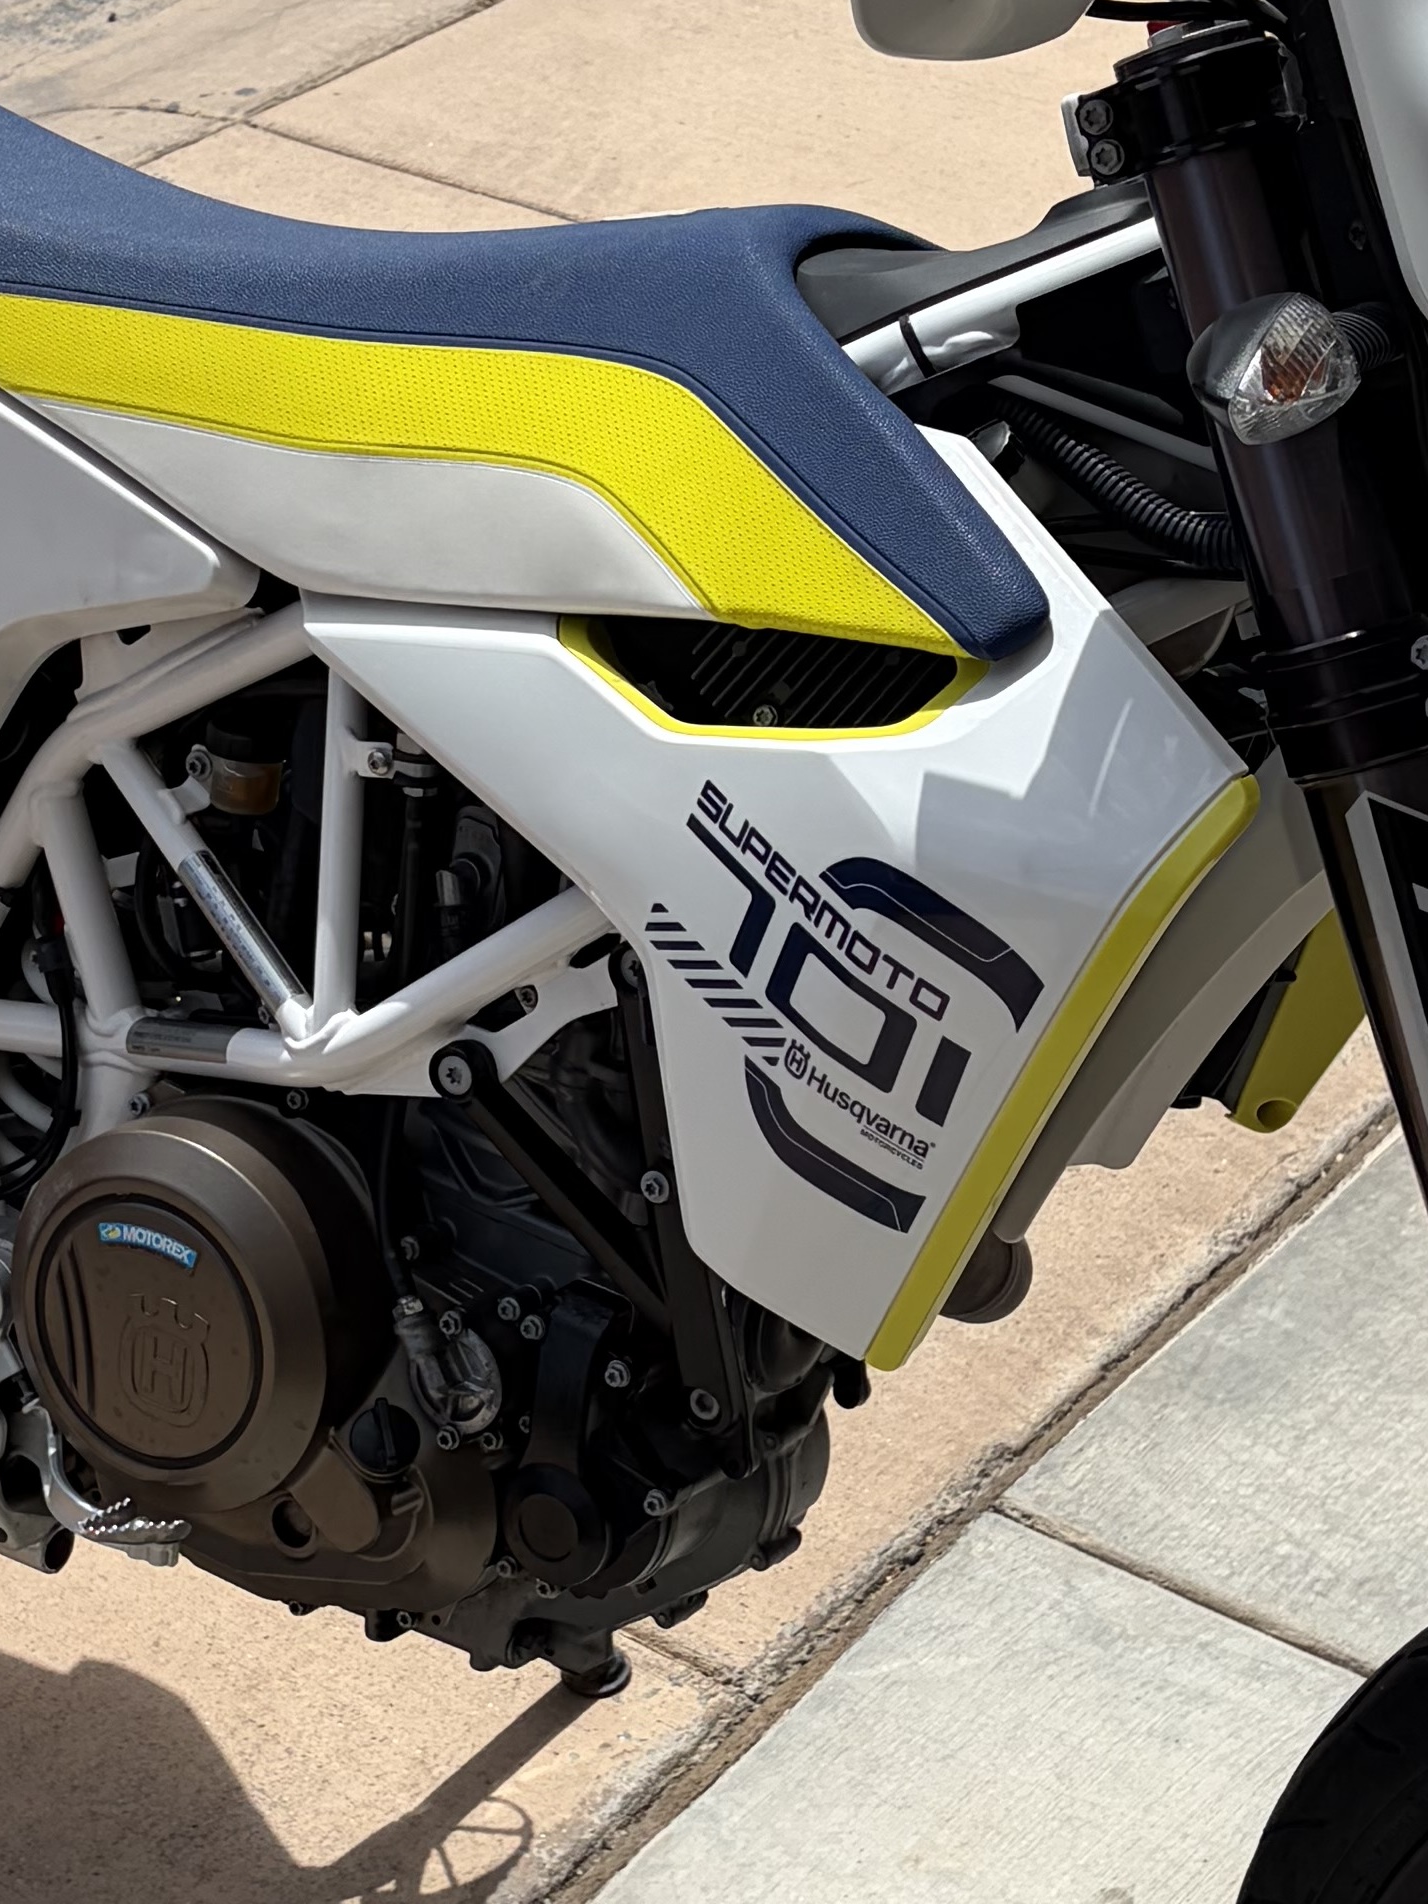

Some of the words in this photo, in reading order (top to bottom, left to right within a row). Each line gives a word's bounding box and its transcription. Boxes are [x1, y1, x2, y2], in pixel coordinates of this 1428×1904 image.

[697, 779, 951, 1022] SUPERMOTO
[806, 1066, 930, 1159] Husqvarna
[860, 1128, 924, 1170] MOTORCYCLES
[123, 1224, 192, 1264] MOTOREX
